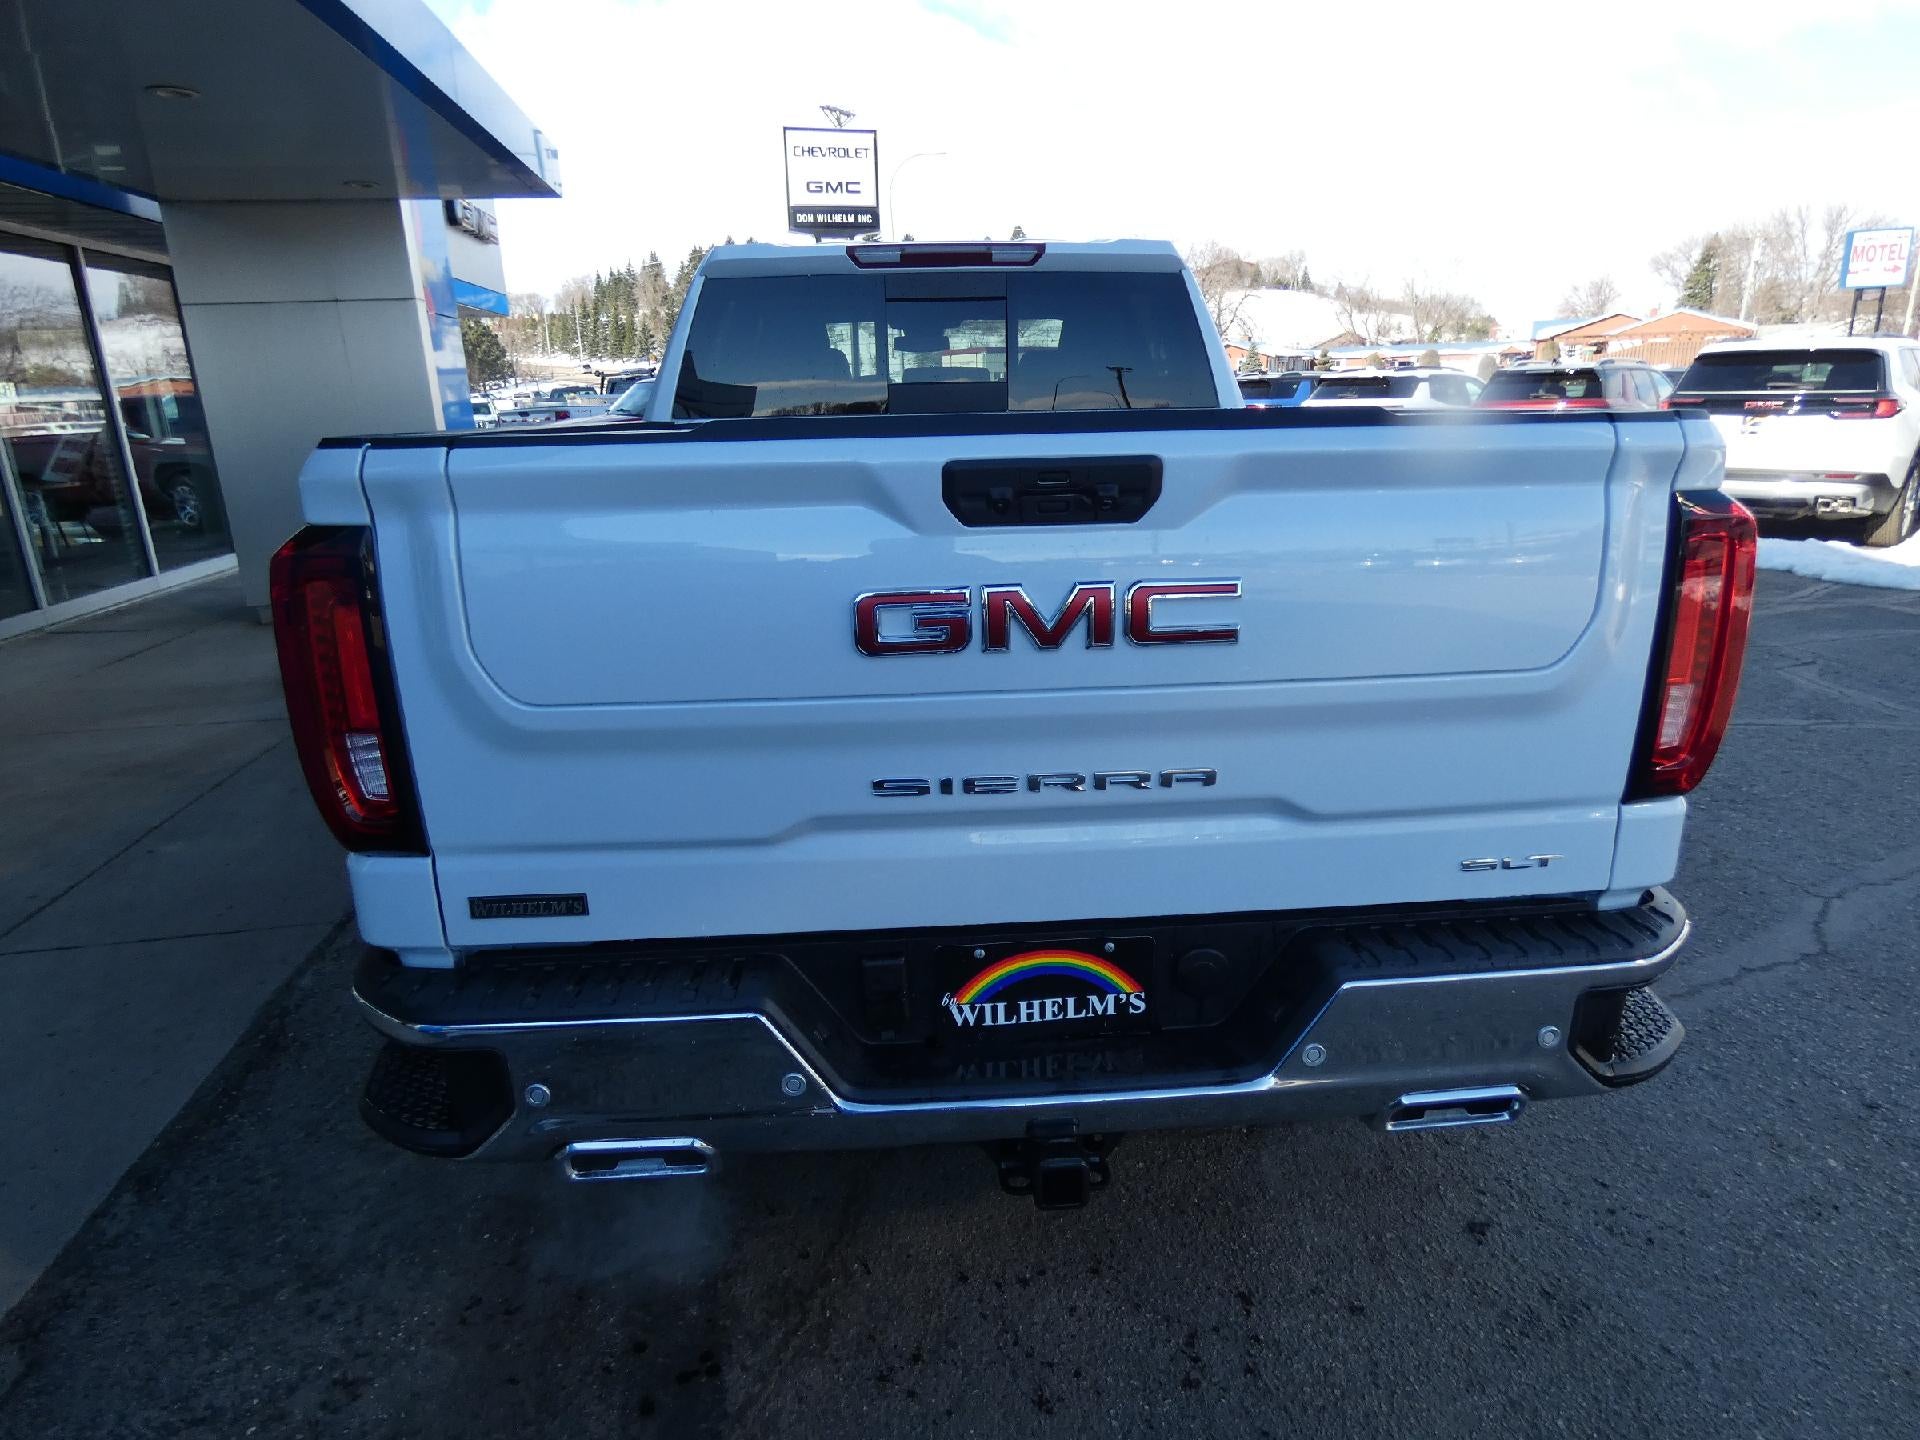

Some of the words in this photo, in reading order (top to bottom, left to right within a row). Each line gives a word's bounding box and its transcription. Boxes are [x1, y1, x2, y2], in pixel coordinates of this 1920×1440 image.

[793, 145, 871, 159] CHEVROLET
[806, 181, 861, 194] GMC
[796, 213, 814, 223] DON
[816, 213, 855, 223] WILHELM
[857, 213, 873, 224] INC
[1851, 243, 1906, 263] MOTEL
[854, 576, 1243, 658] GMC
[871, 766, 1219, 797] SIERRA
[1460, 853, 1566, 872] SLT
[950, 991, 1147, 1027] WILHELM'S
